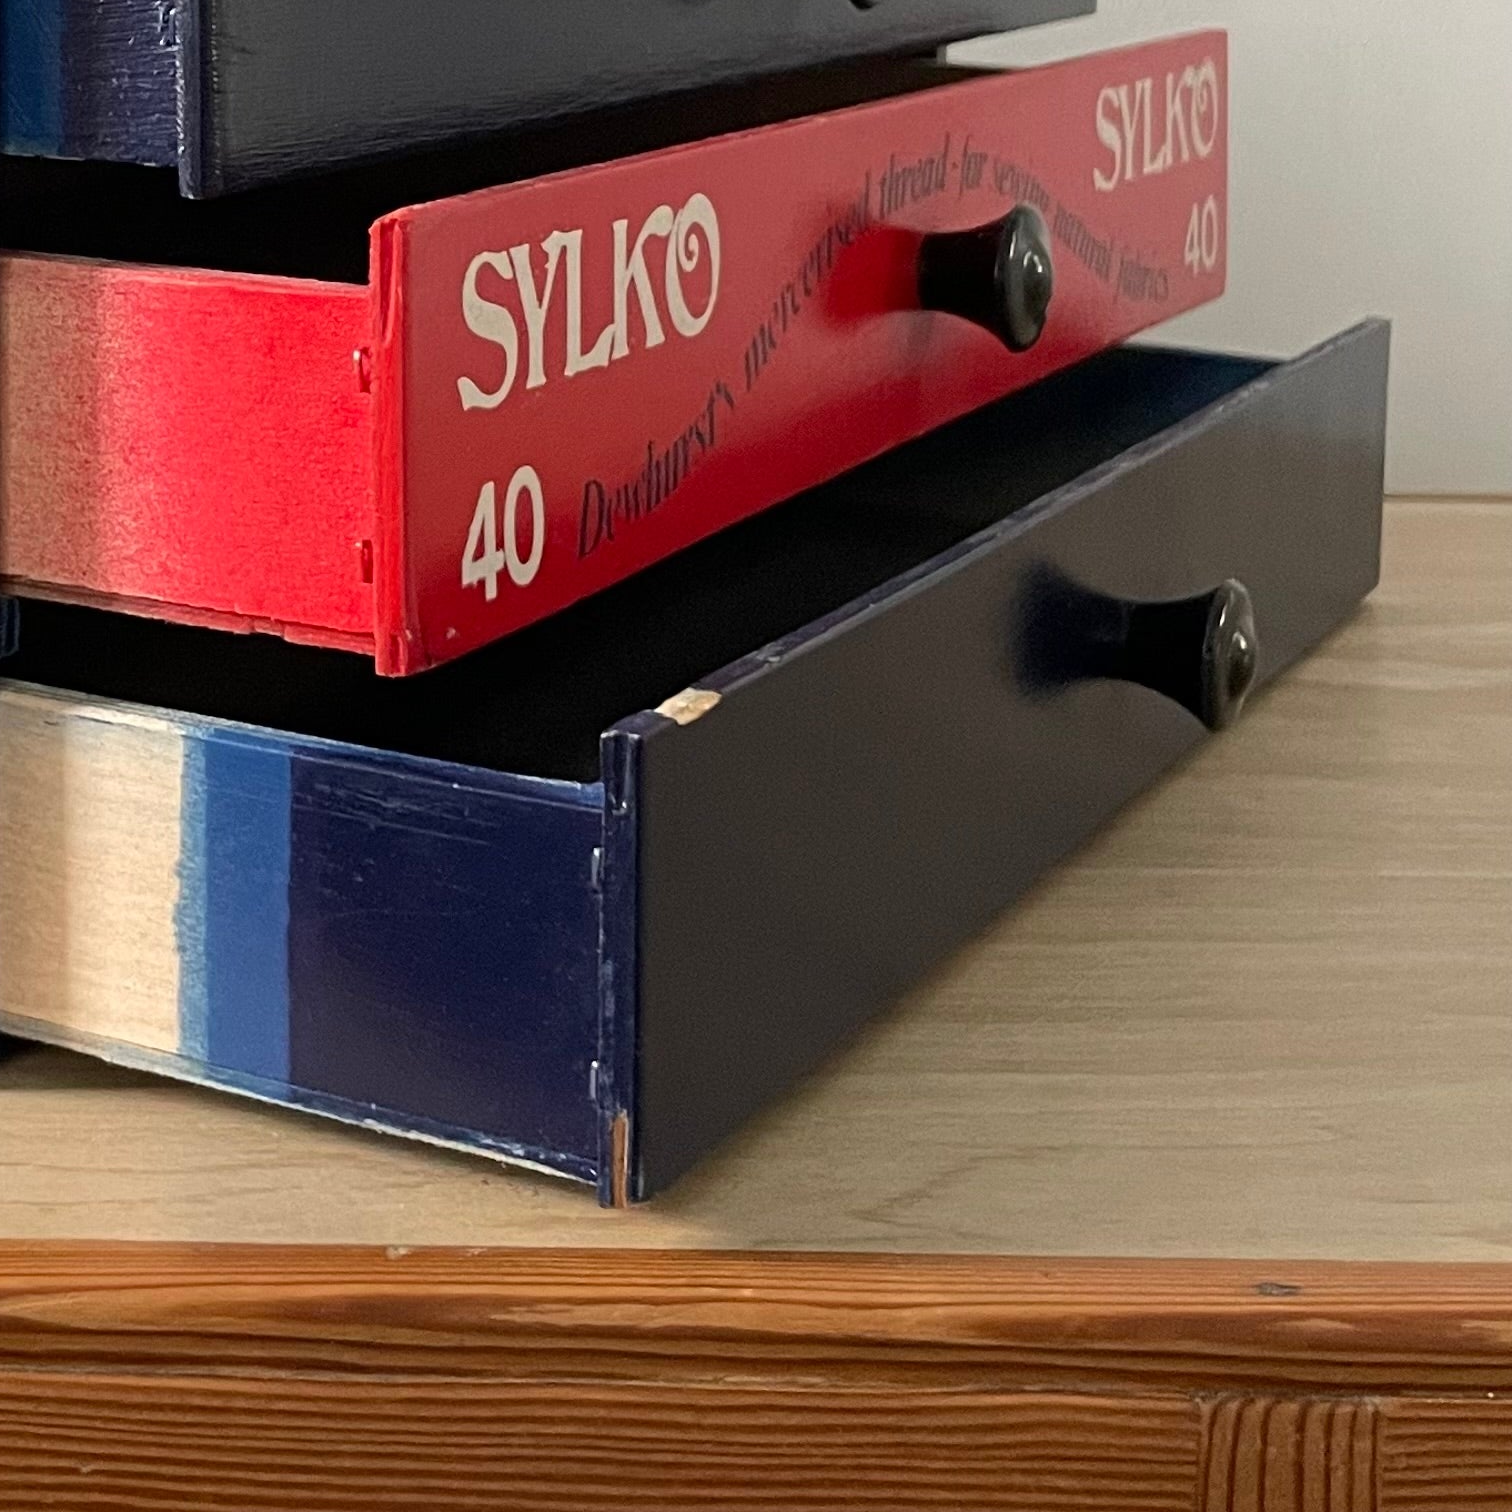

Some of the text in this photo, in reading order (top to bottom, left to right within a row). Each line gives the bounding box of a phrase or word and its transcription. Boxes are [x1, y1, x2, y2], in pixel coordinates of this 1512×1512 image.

[1093, 56, 1219, 192] SYLKO
[457, 193, 721, 411] SYLKO
[1185, 194, 1219, 276] 40
[462, 465, 545, 602] 40
